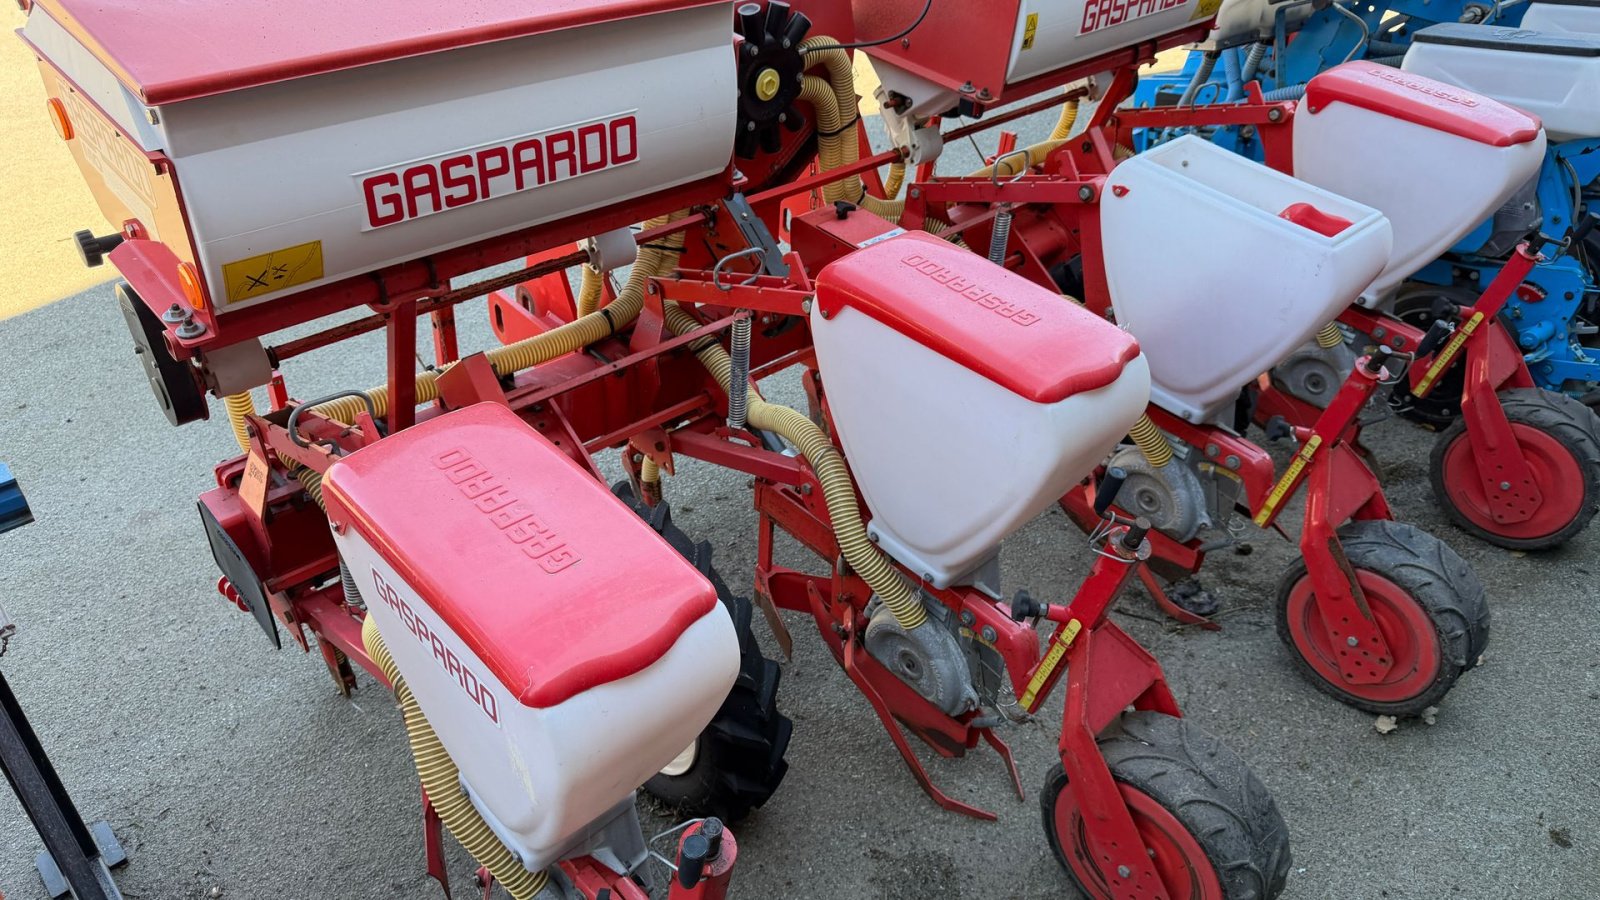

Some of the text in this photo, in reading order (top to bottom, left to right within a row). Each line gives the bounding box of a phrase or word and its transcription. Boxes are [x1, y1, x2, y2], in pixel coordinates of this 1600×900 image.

[363, 116, 637, 227] GASPARDO
[901, 255, 1041, 326] GASPARDO
[431, 446, 582, 574] GASPARDO
[372, 568, 498, 723] GASPARDO
